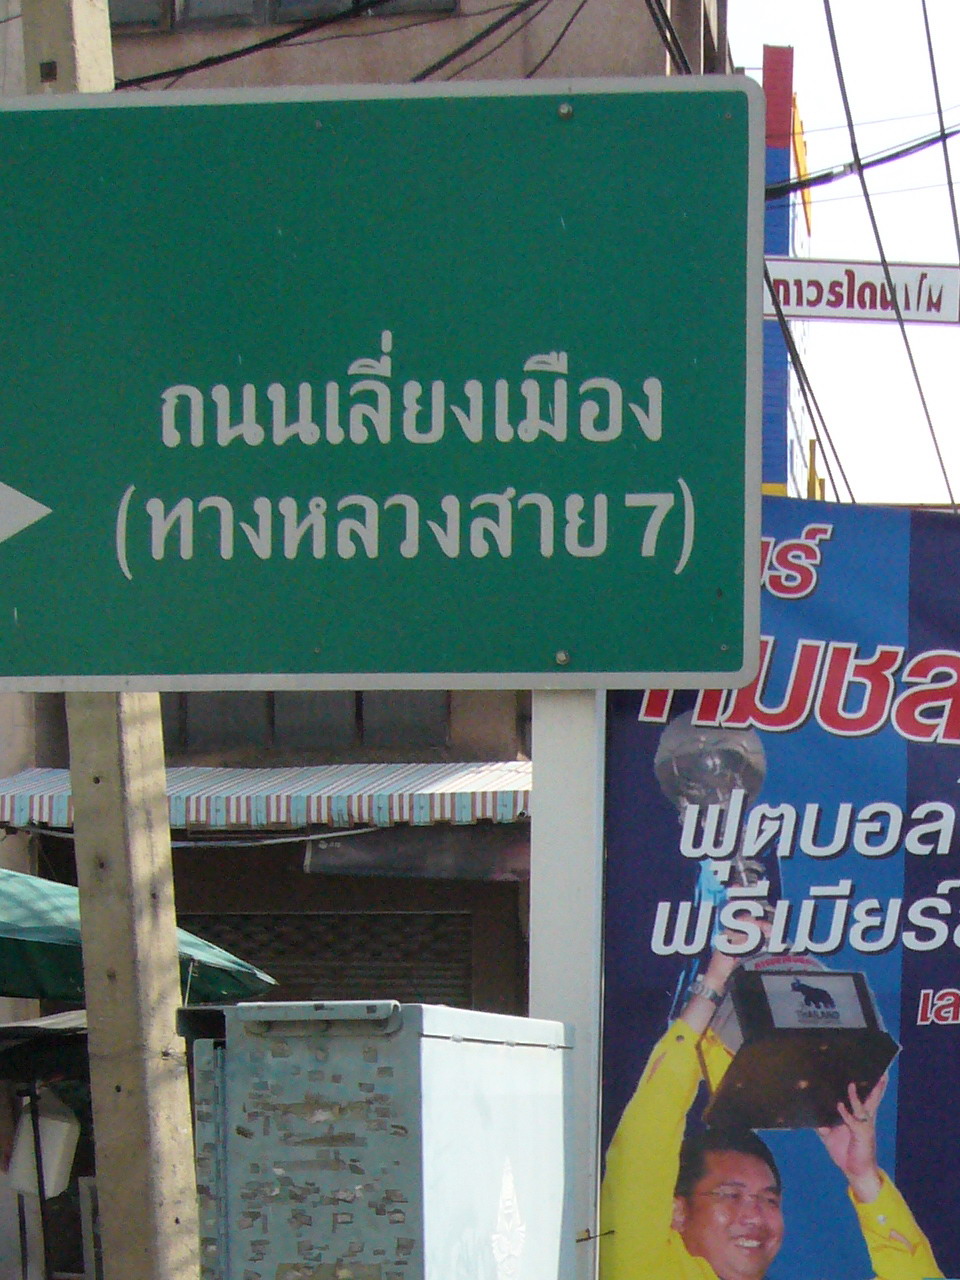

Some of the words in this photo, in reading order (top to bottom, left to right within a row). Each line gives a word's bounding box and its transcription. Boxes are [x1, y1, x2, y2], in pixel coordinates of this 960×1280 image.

[160, 329, 663, 448] ถนนเลี่ยงเมือง
[115, 484, 609, 580] (ทางหลวงสาย
[625, 477, 695, 575] 7)
